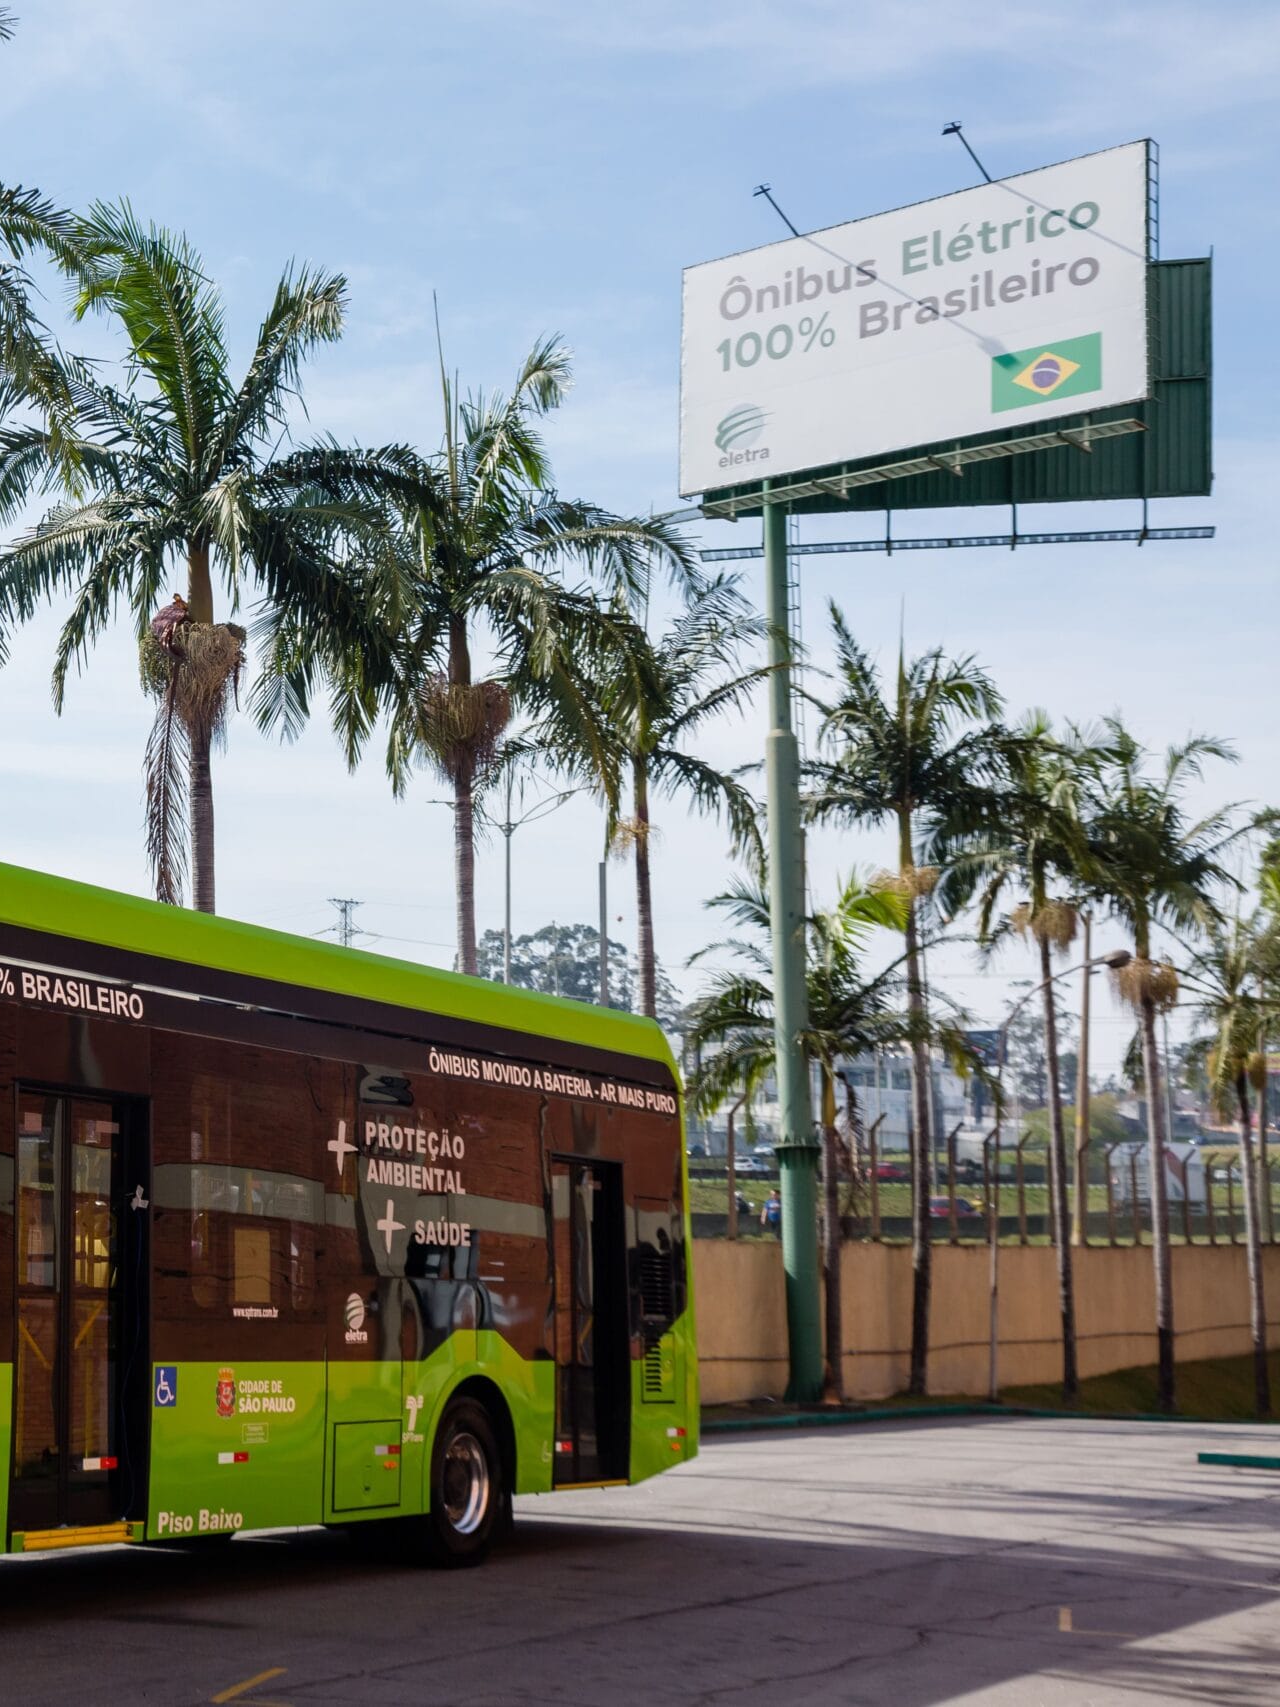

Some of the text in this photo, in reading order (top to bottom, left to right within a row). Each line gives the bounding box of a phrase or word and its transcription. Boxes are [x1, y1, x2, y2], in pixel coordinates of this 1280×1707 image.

[719, 200, 1100, 321] Ônibus Elétrico
[716, 256, 1100, 372] 100% Brasileiro
[718, 445, 770, 468] eletra
[22, 972, 144, 1020] BRASILEIRO
[429, 1047, 480, 1078] ÔNIBUS
[483, 1065, 531, 1087] MOVIDO
[533, 1071, 543, 1089] A
[544, 1072, 593, 1098] BATERIA
[600, 1083, 616, 1101] AR
[618, 1085, 645, 1108] MAIS
[647, 1092, 676, 1114] PURO
[366, 1159, 466, 1195] AMBIENTAL
[414, 1216, 471, 1247] SAÚDE
[345, 1330, 368, 1341] eletra
[238, 1380, 283, 1394] CIDADE DE
[238, 1394, 296, 1413] SÃO PAULO
[158, 1508, 244, 1534] Piso Baixo
